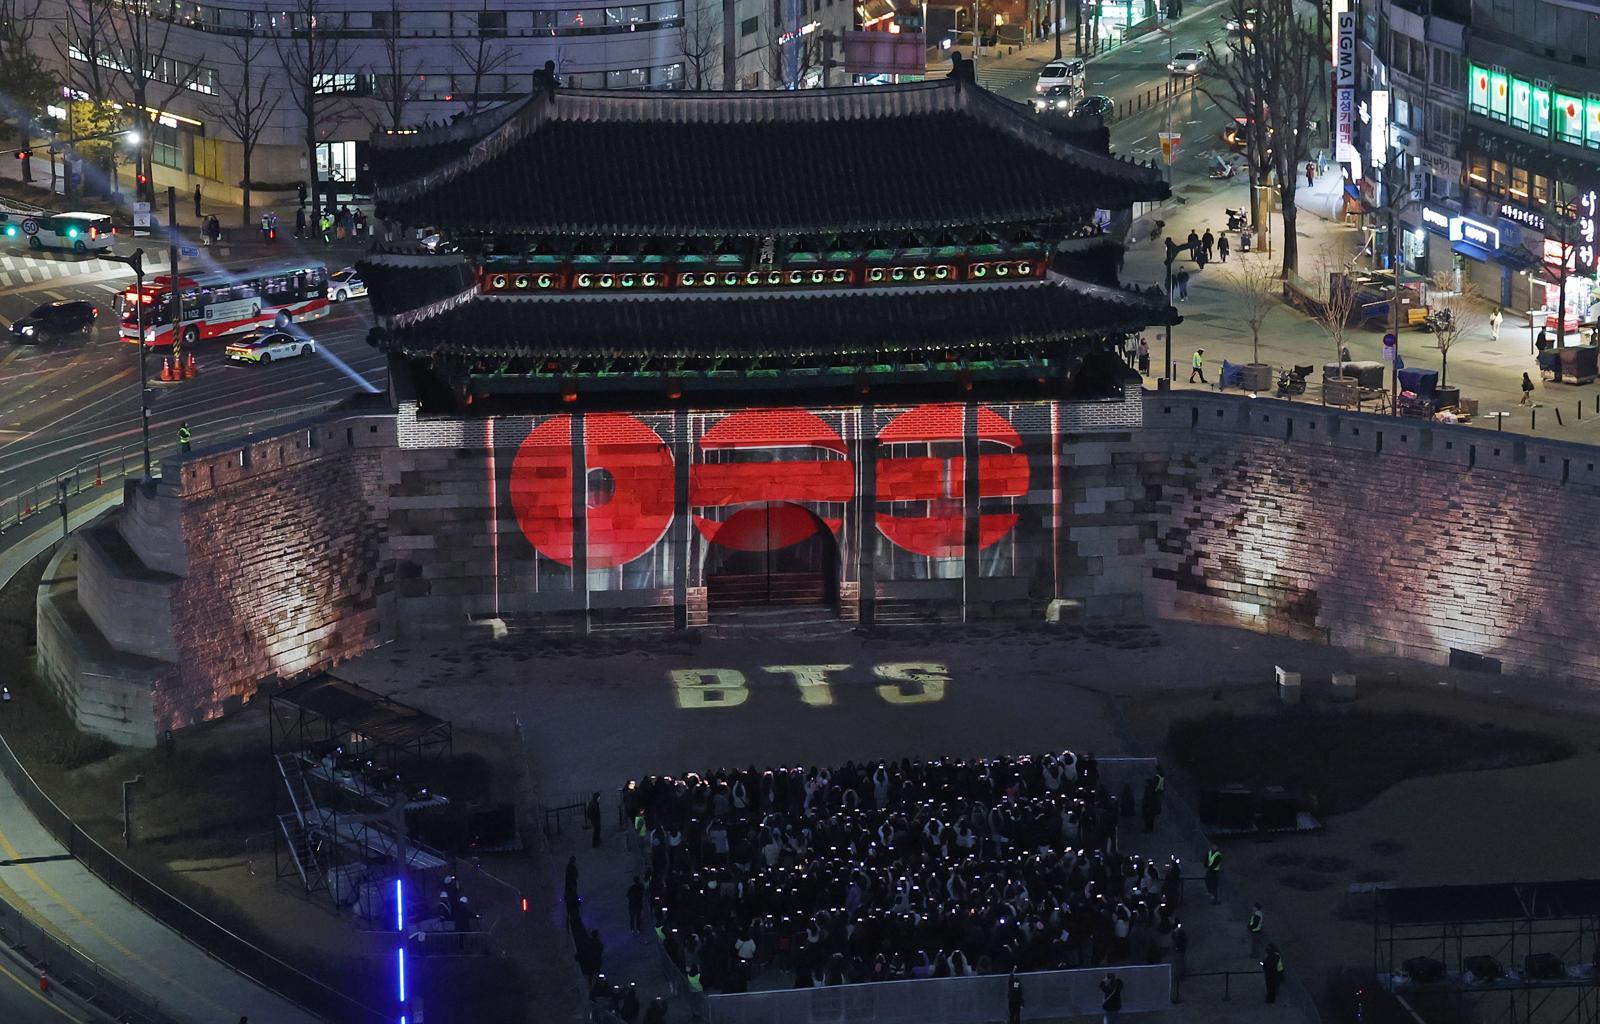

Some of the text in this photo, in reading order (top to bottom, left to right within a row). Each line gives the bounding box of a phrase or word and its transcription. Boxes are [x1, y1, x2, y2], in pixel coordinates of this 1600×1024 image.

[1340, 16, 1353, 81] SIGMA
[1339, 90, 1352, 145] 효성카메라
[25, 222, 36, 232] 50
[670, 662, 953, 709] BTS
